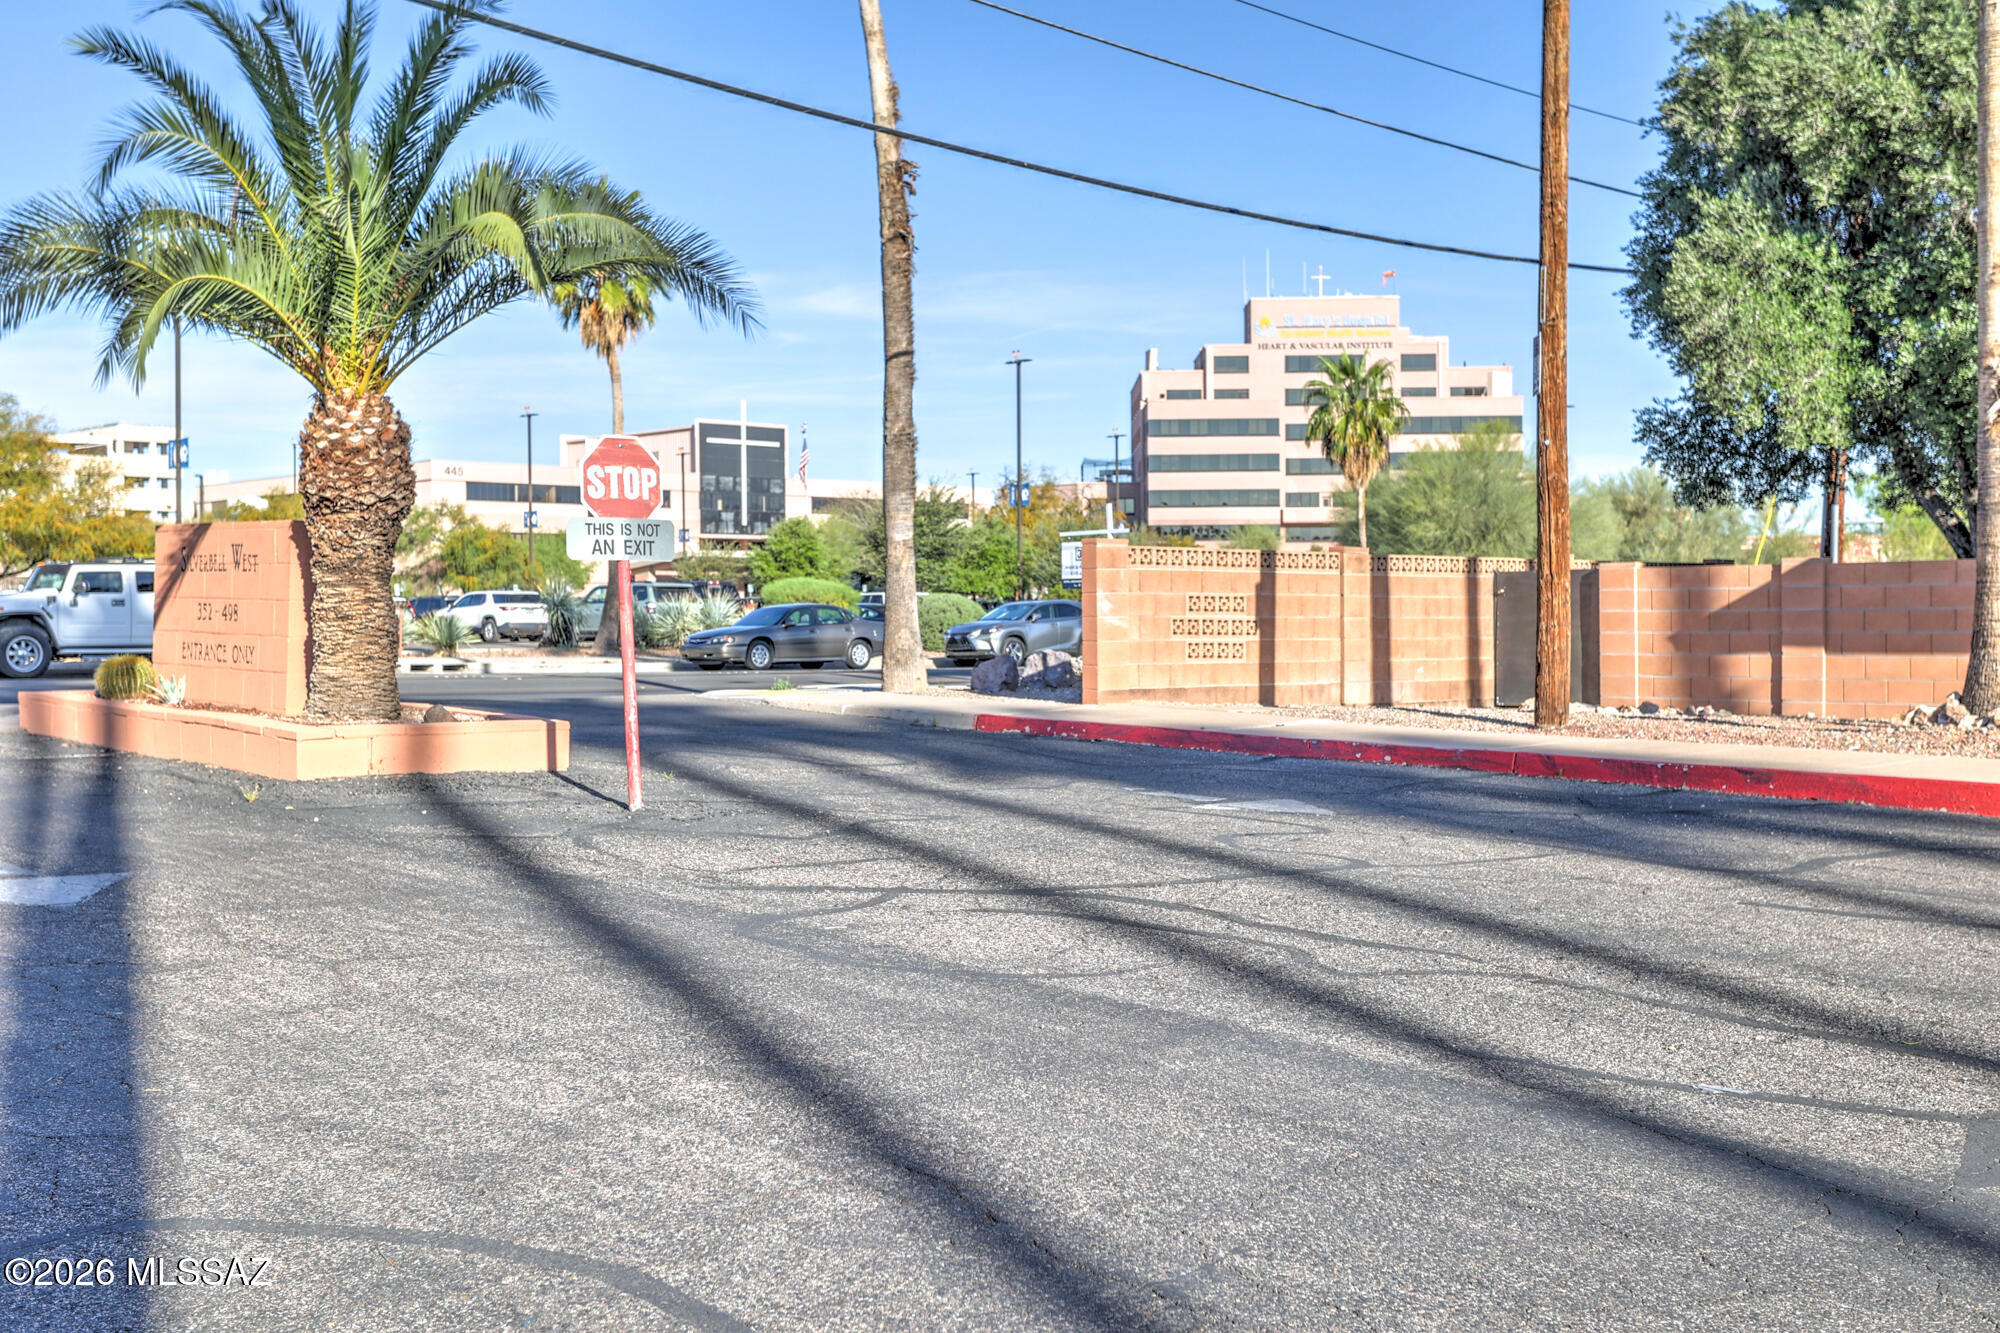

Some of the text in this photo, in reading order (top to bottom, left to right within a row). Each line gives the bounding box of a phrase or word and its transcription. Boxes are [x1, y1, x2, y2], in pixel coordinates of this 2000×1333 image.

[1300, 342, 1344, 350] VASCULAR
[1347, 341, 1393, 350] INSTITUTE
[586, 465, 658, 500] STOP
[585, 522, 660, 537] THIS IS NOT
[592, 539, 655, 556] AN EXIT
[197, 602, 213, 621] 352
[221, 603, 239, 621] 498
[181, 641, 255, 664] ENTRANCE ONLY
